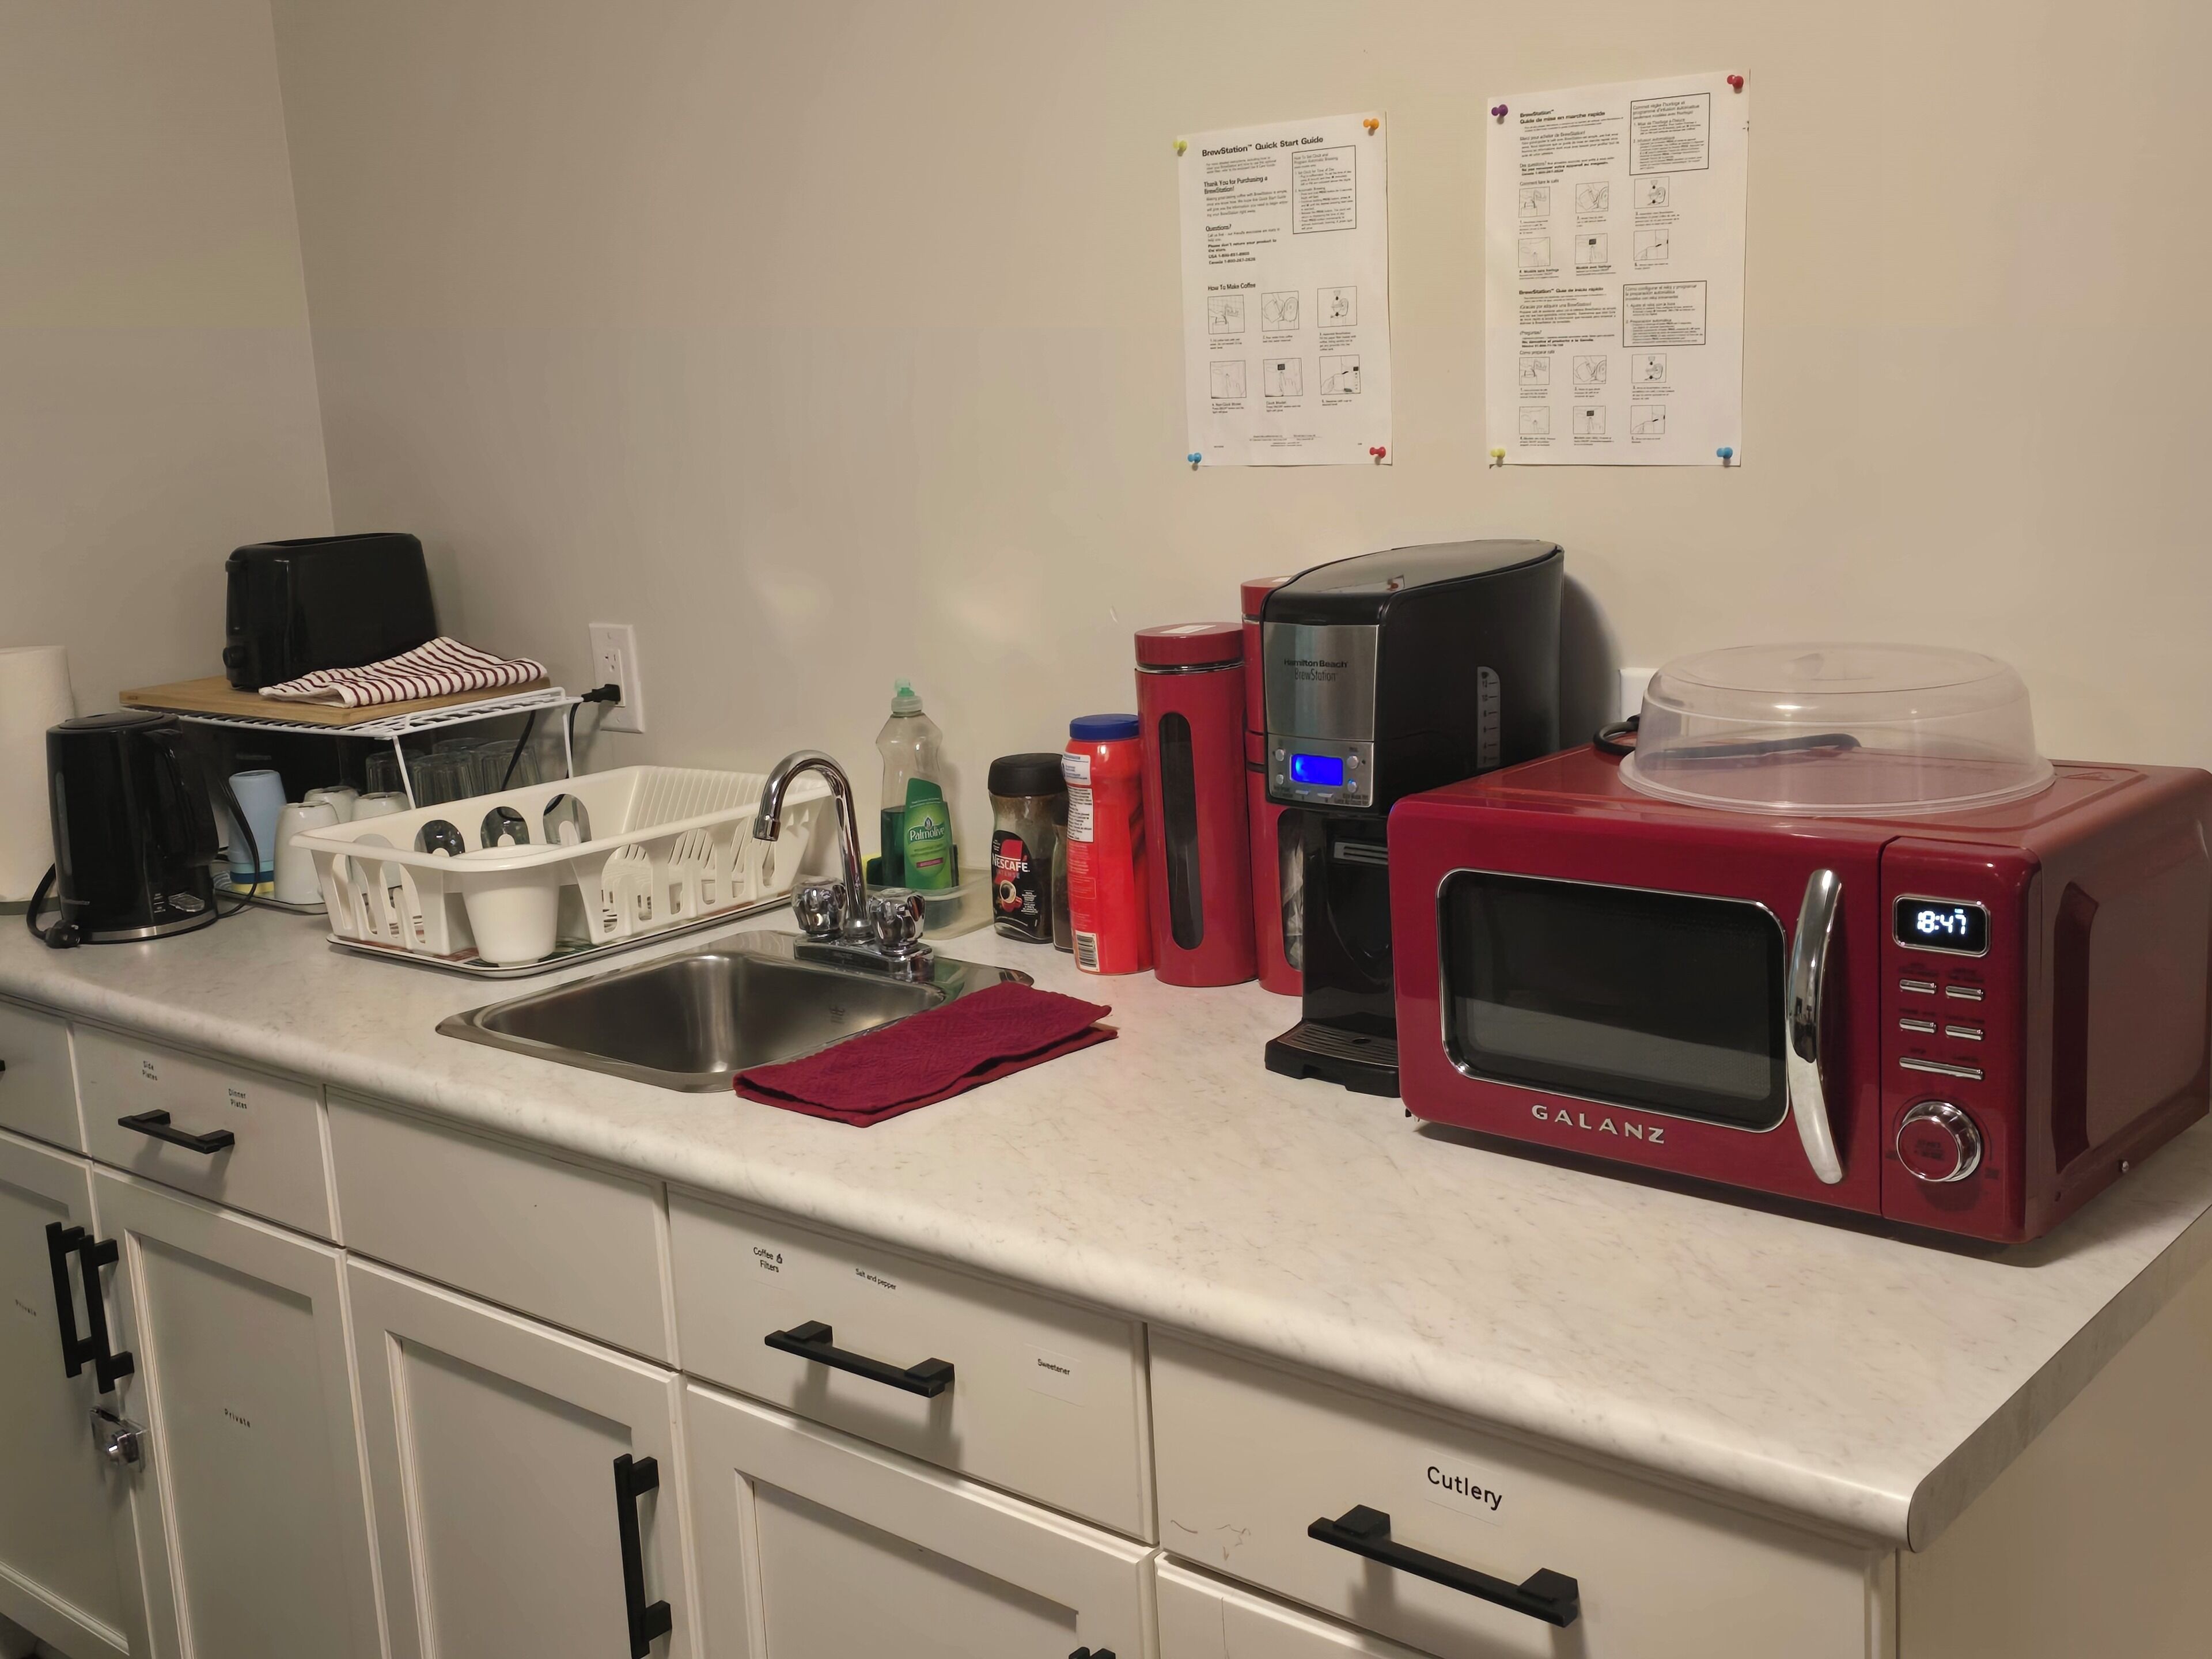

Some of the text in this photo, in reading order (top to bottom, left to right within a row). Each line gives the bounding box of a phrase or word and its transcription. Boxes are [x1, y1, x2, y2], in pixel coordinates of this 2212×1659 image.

[1255, 142, 1277, 150] Quick
[1280, 139, 1298, 147] Start
[1301, 136, 1323, 144] Guide
[1284, 658, 1347, 668] Hamilton Beach
[910, 827, 945, 841] Palmolive
[1532, 1105, 1664, 1144] GALANZ
[753, 1247, 774, 1260] Coffee
[760, 1260, 779, 1272] Filters
[855, 1268, 896, 1290] Salt and pepper
[1427, 1466, 1502, 1511] Cutlery
